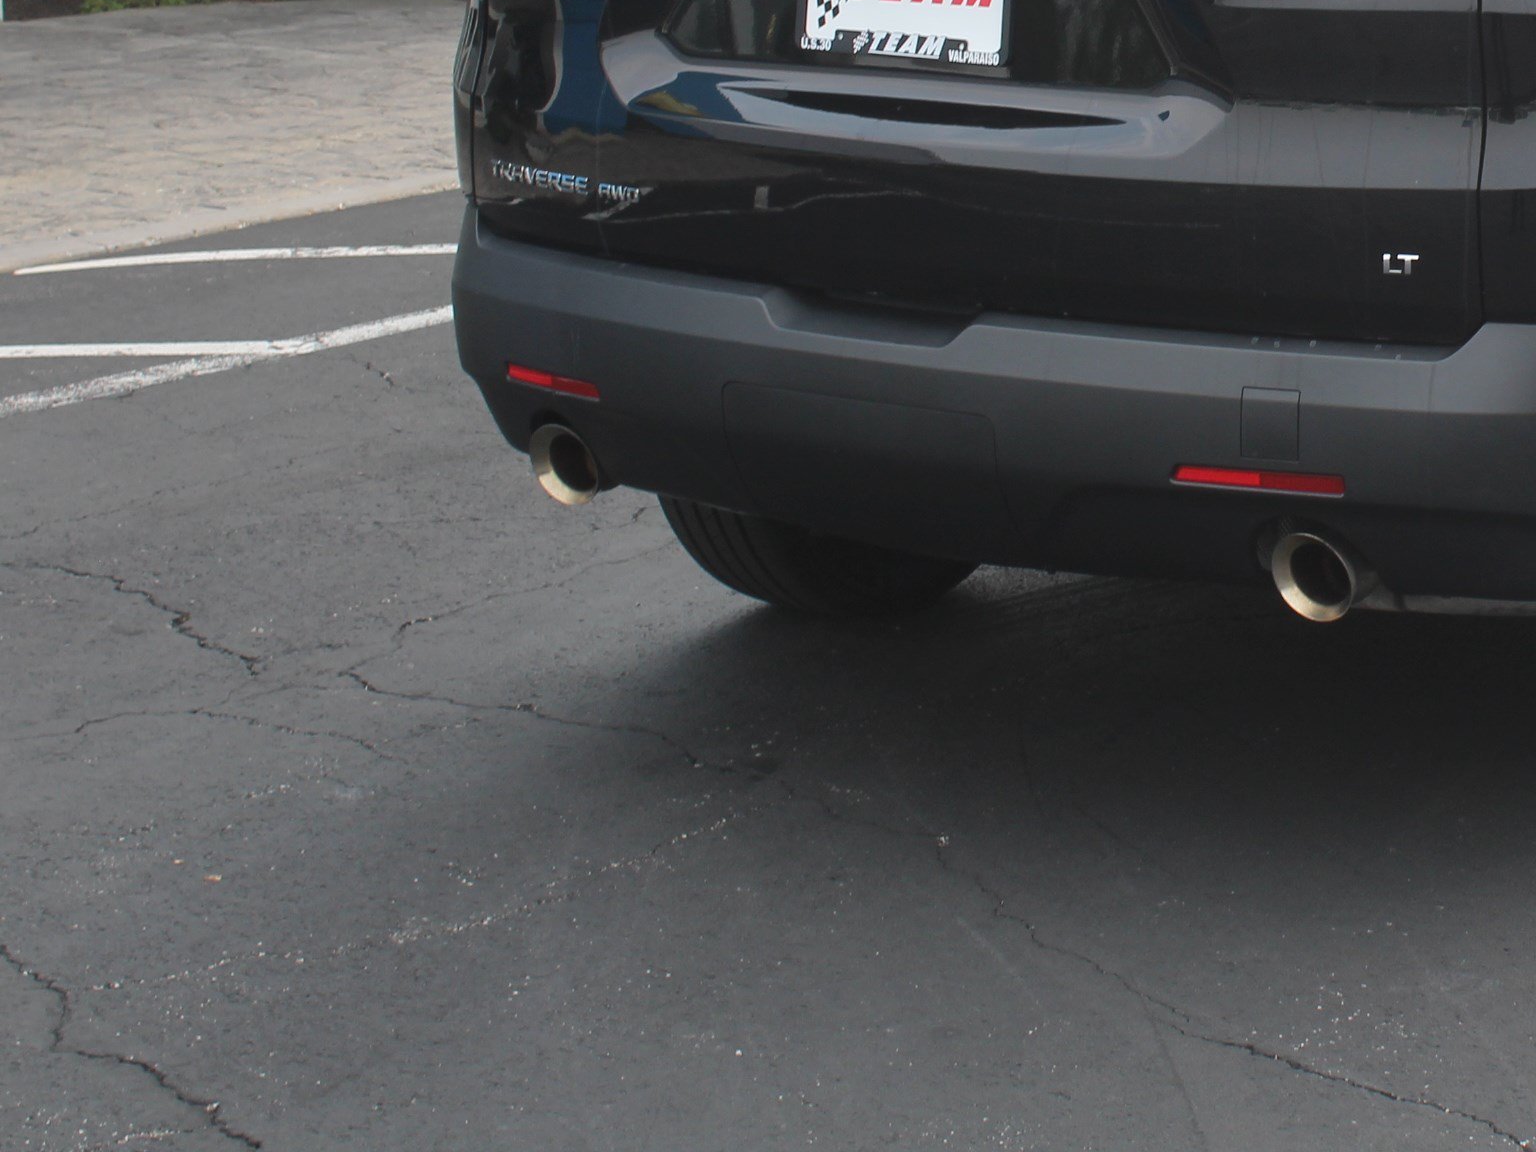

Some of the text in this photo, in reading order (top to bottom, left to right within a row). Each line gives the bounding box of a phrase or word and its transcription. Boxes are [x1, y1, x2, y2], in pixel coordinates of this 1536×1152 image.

[868, 30, 946, 57] TEAM
[948, 48, 1000, 66] VALPARAISO
[492, 159, 640, 203] TRAVERSE AWD
[1382, 253, 1419, 275] LT
